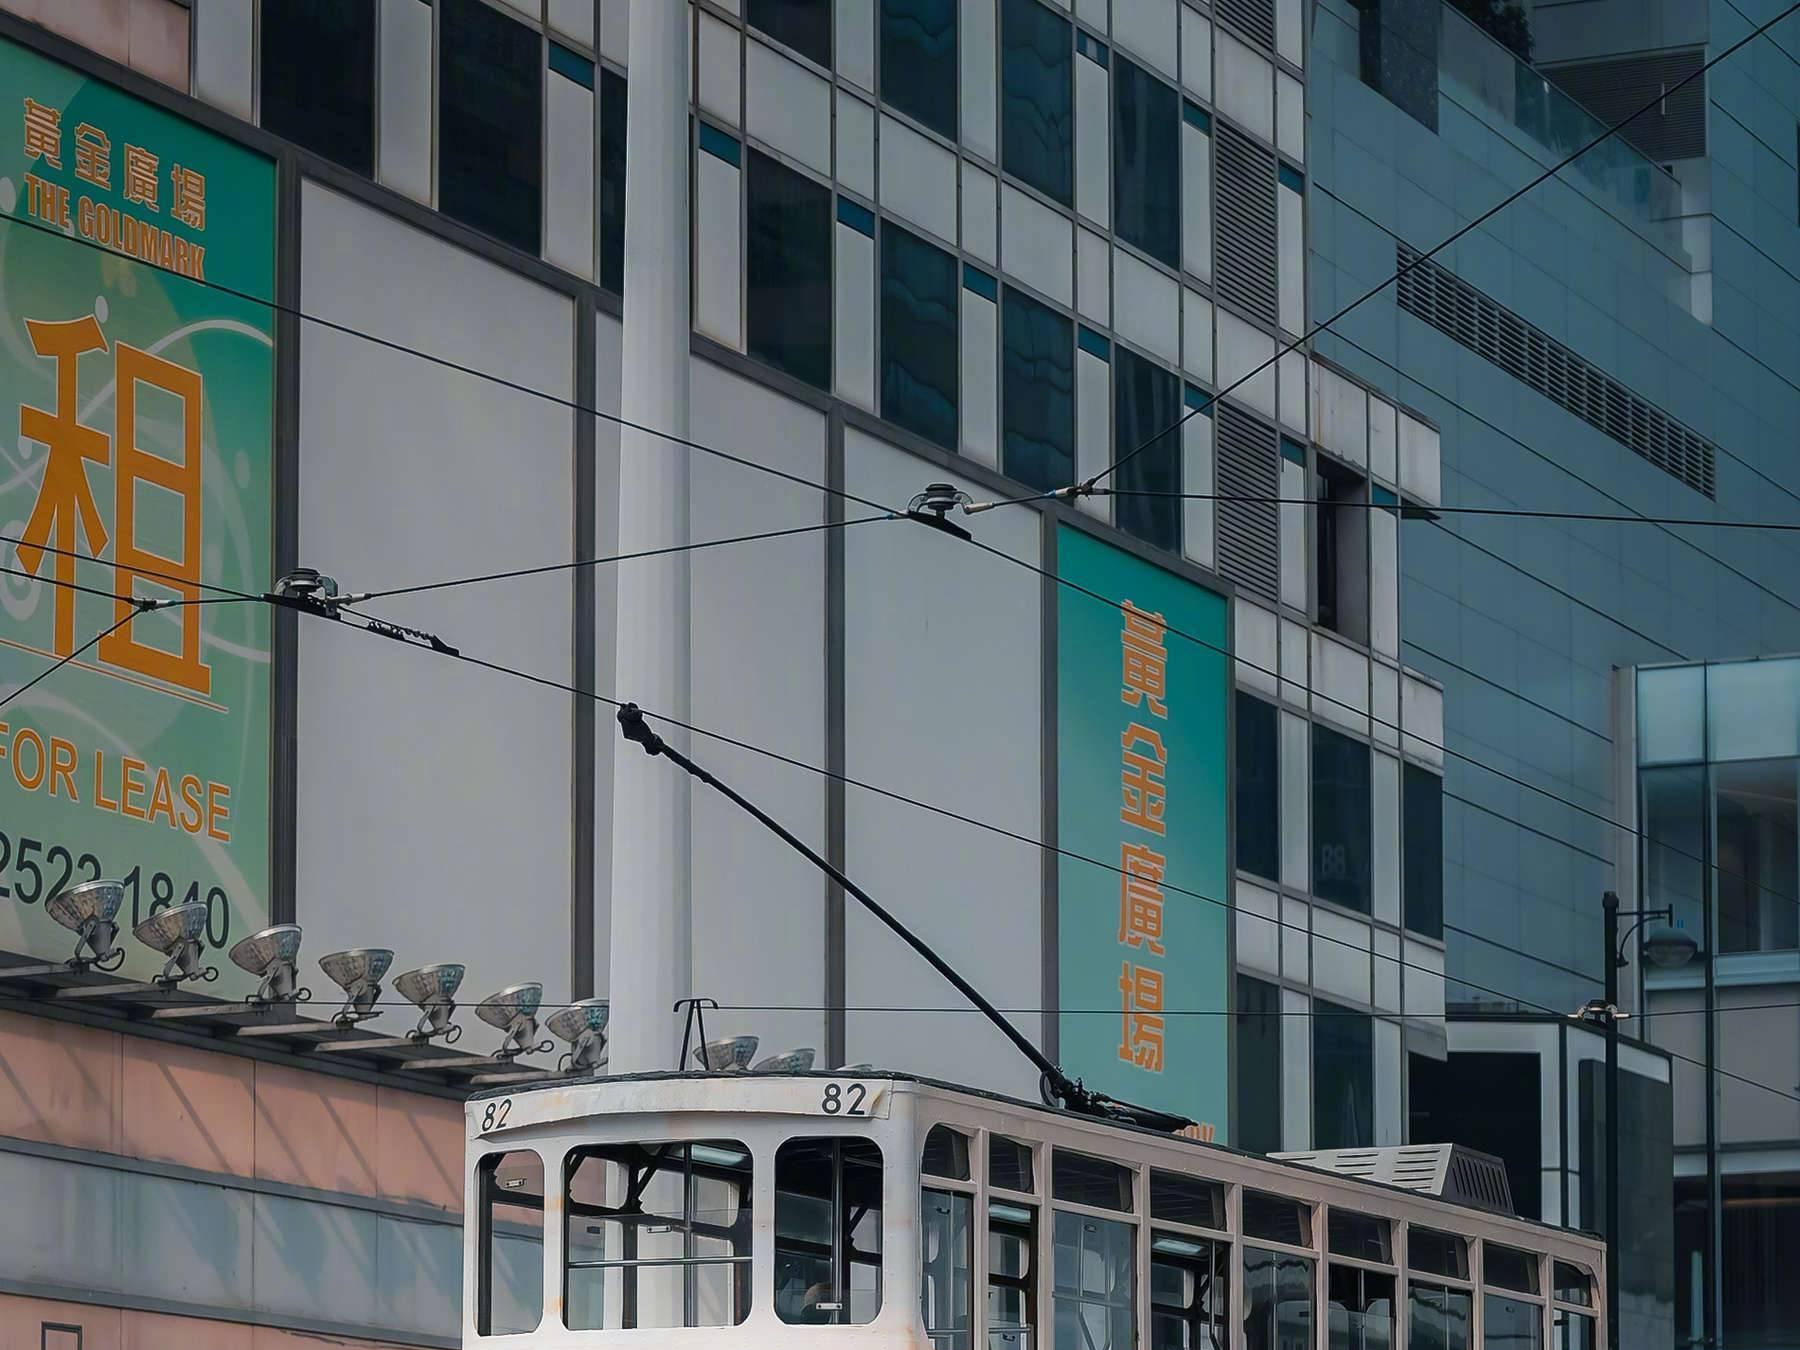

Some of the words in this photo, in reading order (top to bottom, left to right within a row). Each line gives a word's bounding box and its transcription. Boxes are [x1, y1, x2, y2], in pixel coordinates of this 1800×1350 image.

[24, 97, 206, 231] 黃金廣場
[25, 172, 72, 230] THE
[77, 195, 206, 286] GOLDMARK
[15, 314, 212, 697] 租
[93, 749, 232, 842] LEASE
[1118, 598, 1168, 1074] 黃金廣場
[481, 1098, 513, 1132] 82
[821, 1083, 866, 1115] 82
